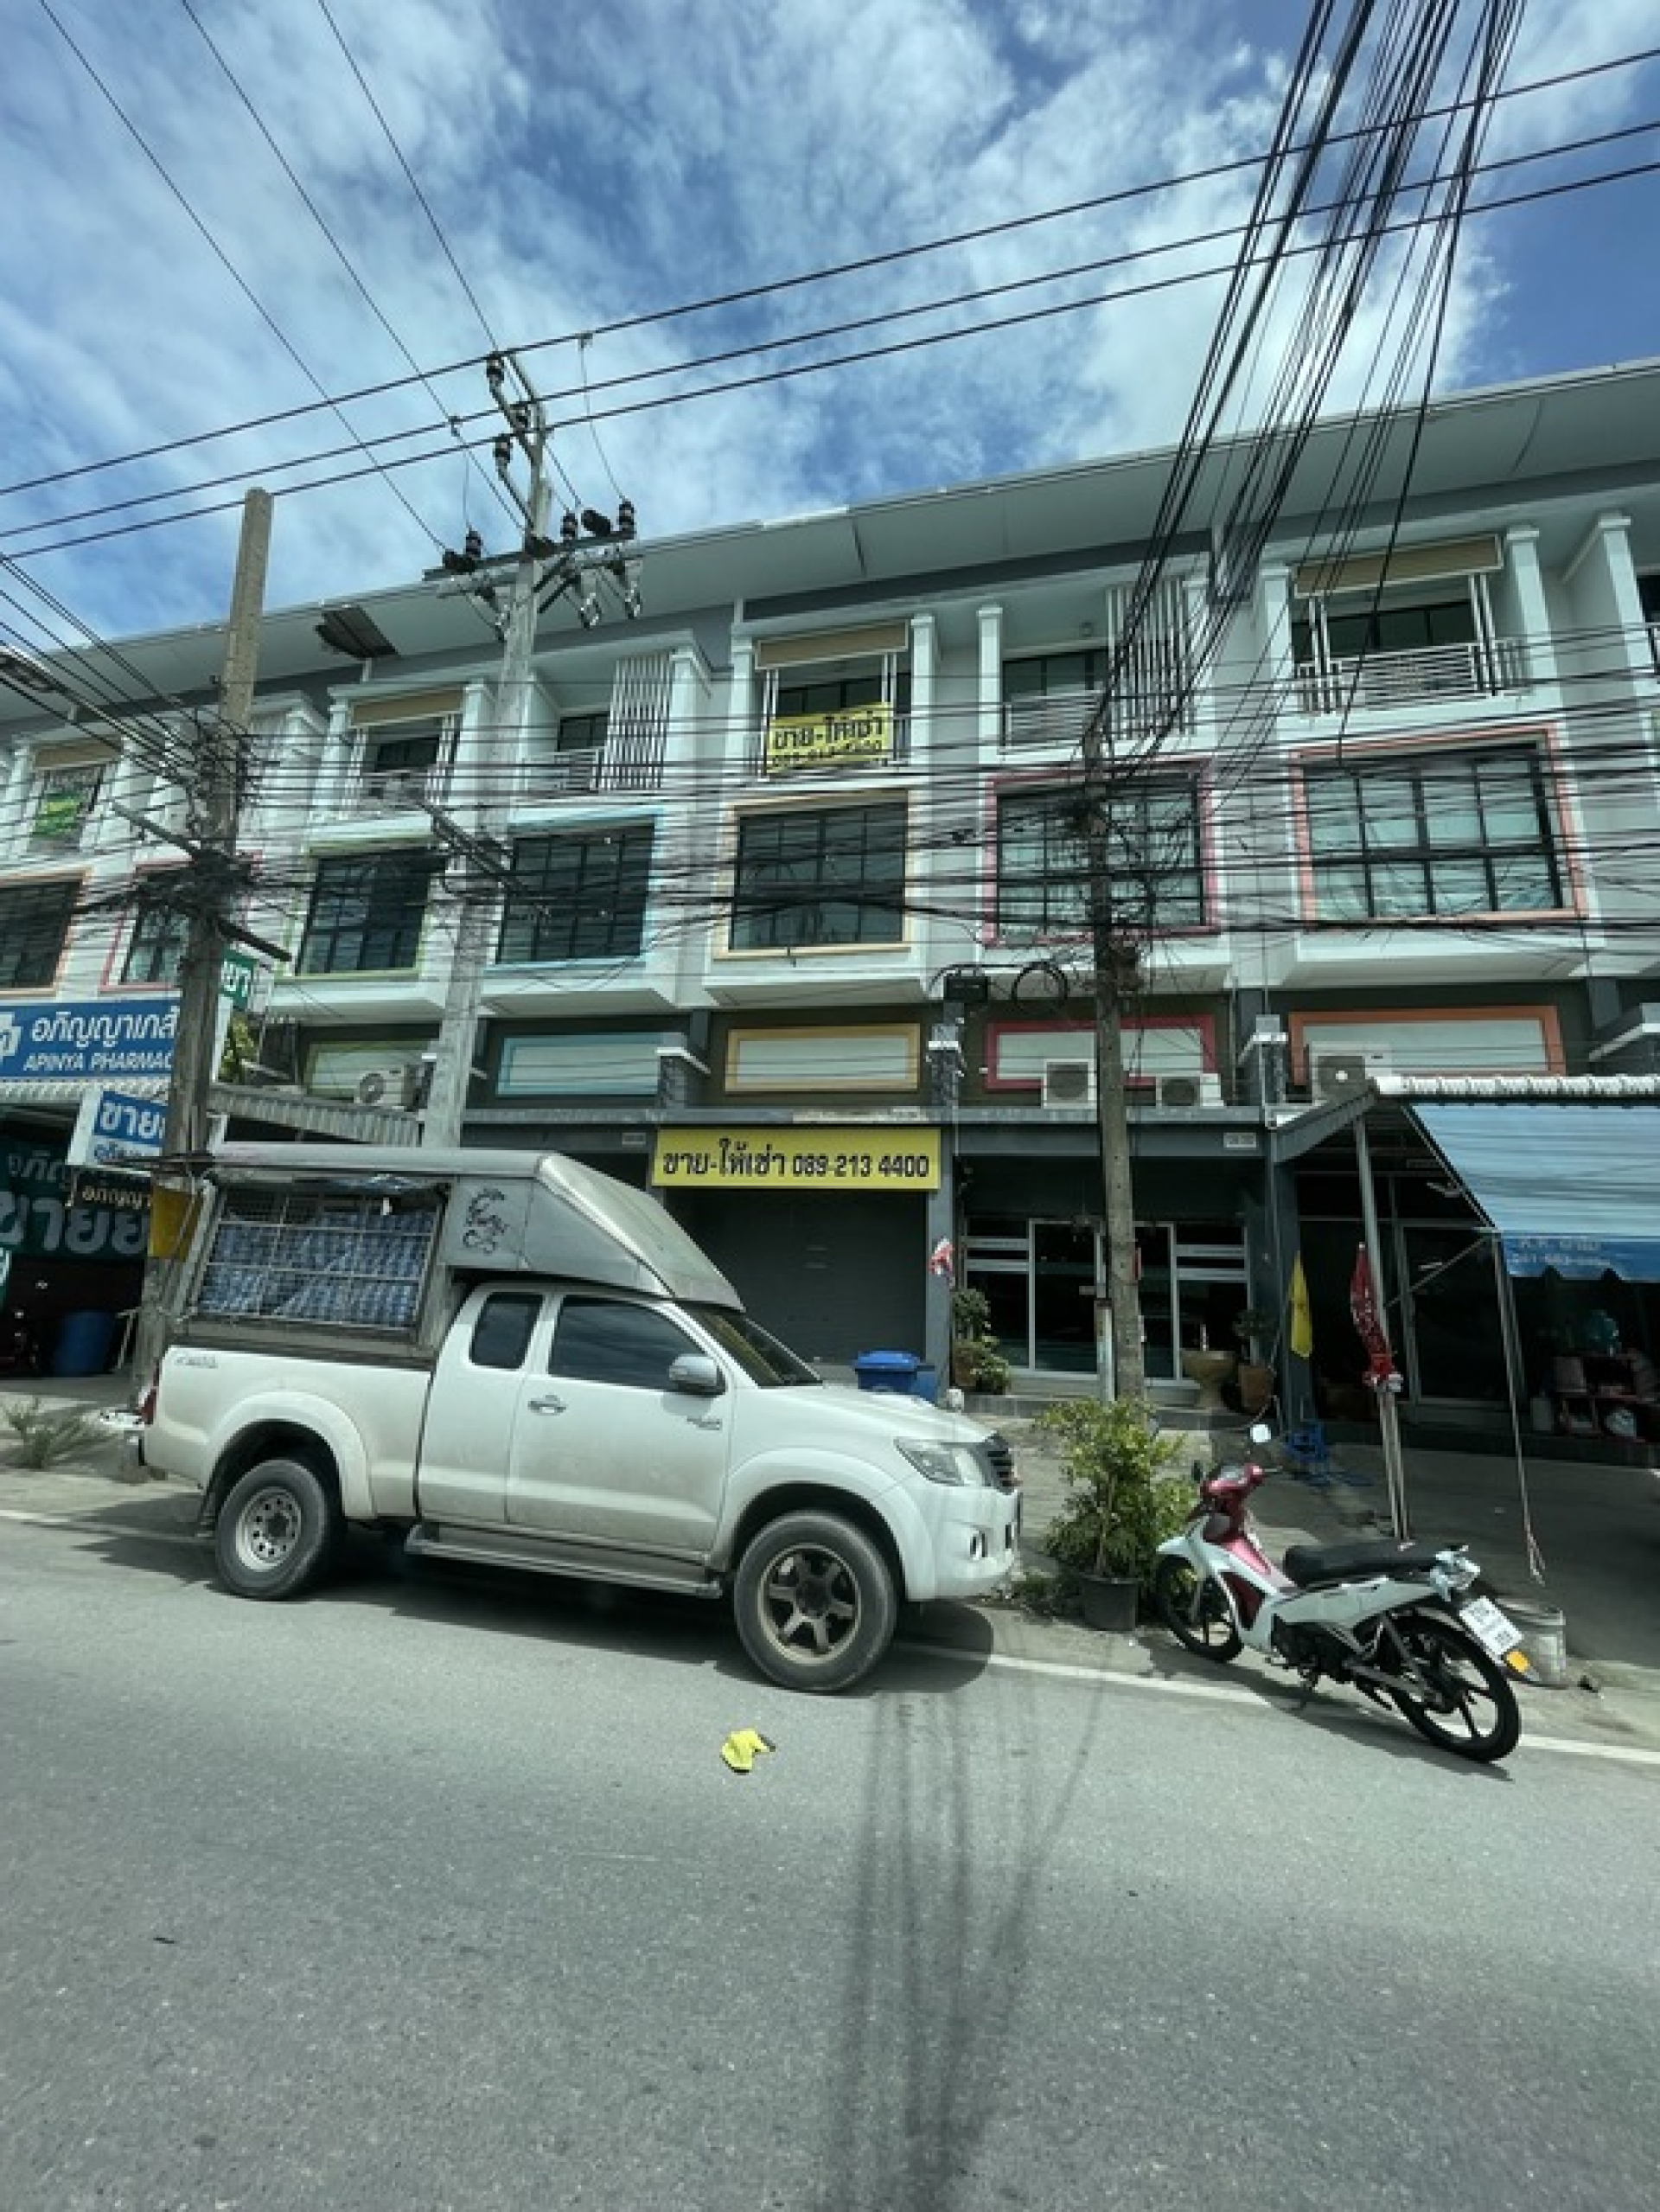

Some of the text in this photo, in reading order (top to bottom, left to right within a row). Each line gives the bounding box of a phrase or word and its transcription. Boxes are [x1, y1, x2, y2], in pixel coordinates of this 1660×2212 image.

[23, 1052, 85, 1071] APINYA
[663, 1138, 785, 1176] ขาย-ให้เช่า
[878, 1154, 930, 1178] 4400
